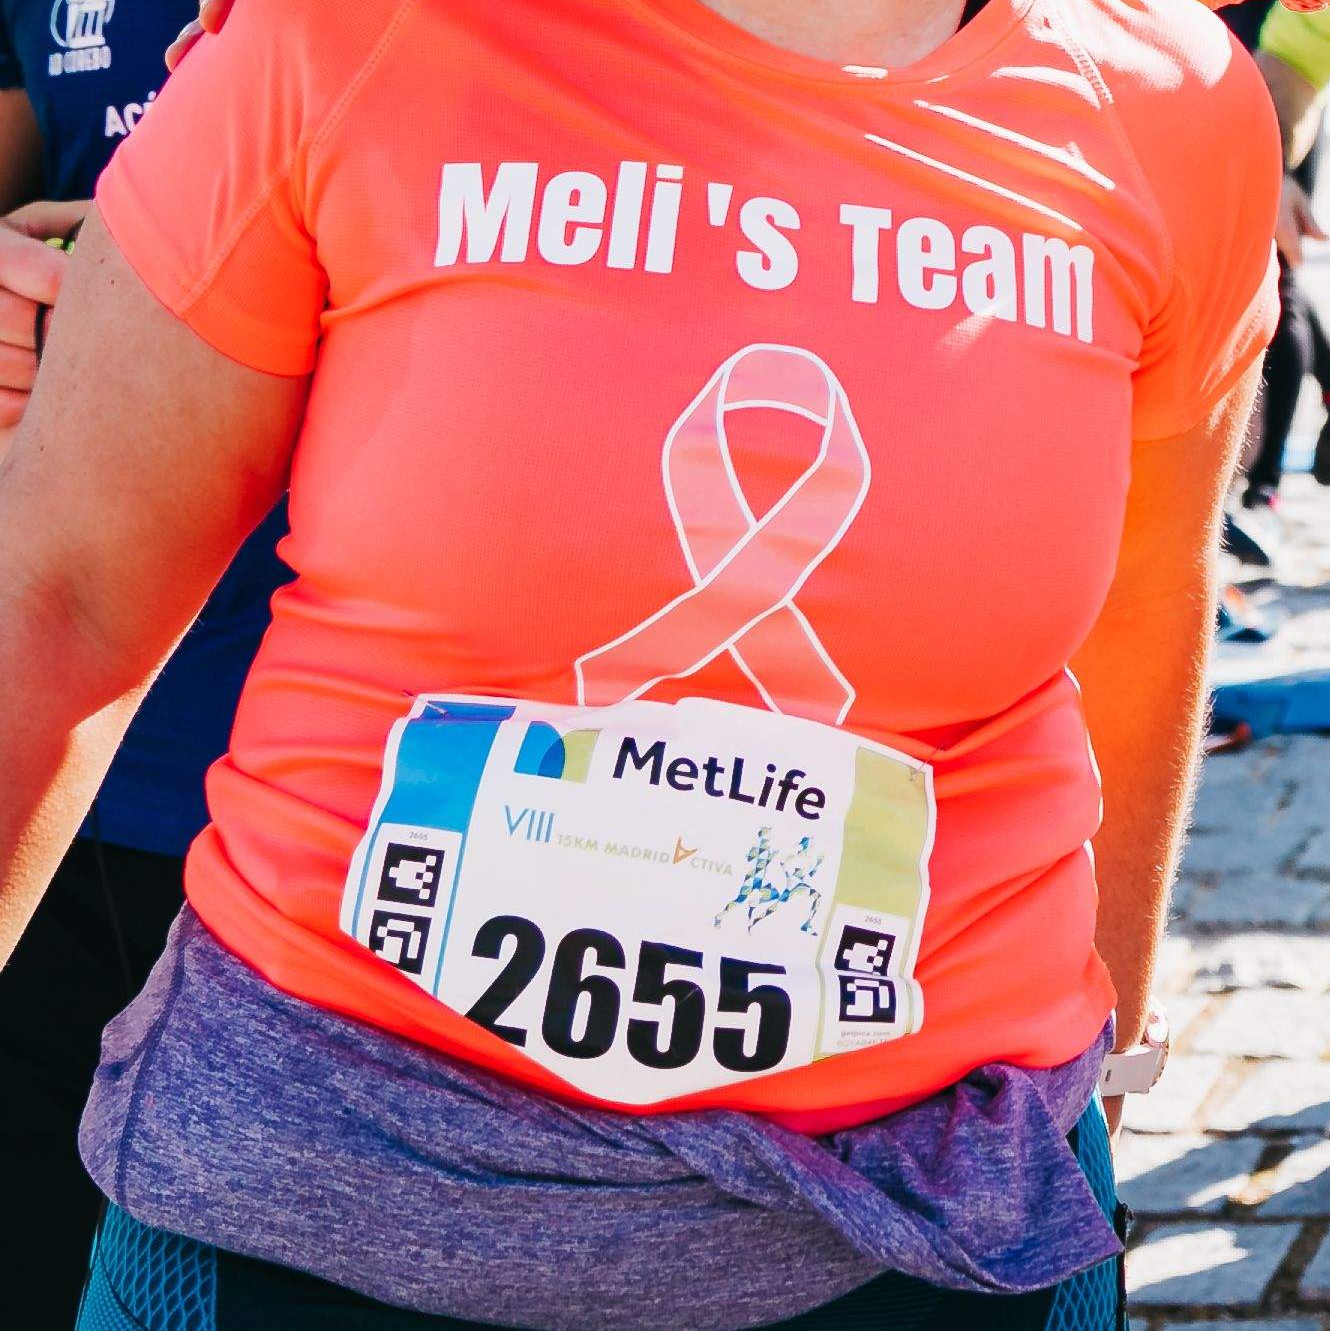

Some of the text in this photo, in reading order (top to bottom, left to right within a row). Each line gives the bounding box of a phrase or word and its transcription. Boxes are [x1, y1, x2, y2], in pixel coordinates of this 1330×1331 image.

[839, 203, 1095, 343] Team
[504, 804, 554, 843] VIII
[557, 833, 599, 852] 15KM
[604, 842, 671, 864] MADRID
[612, 736, 826, 821] MetLife
[465, 914, 793, 1073] 2655
